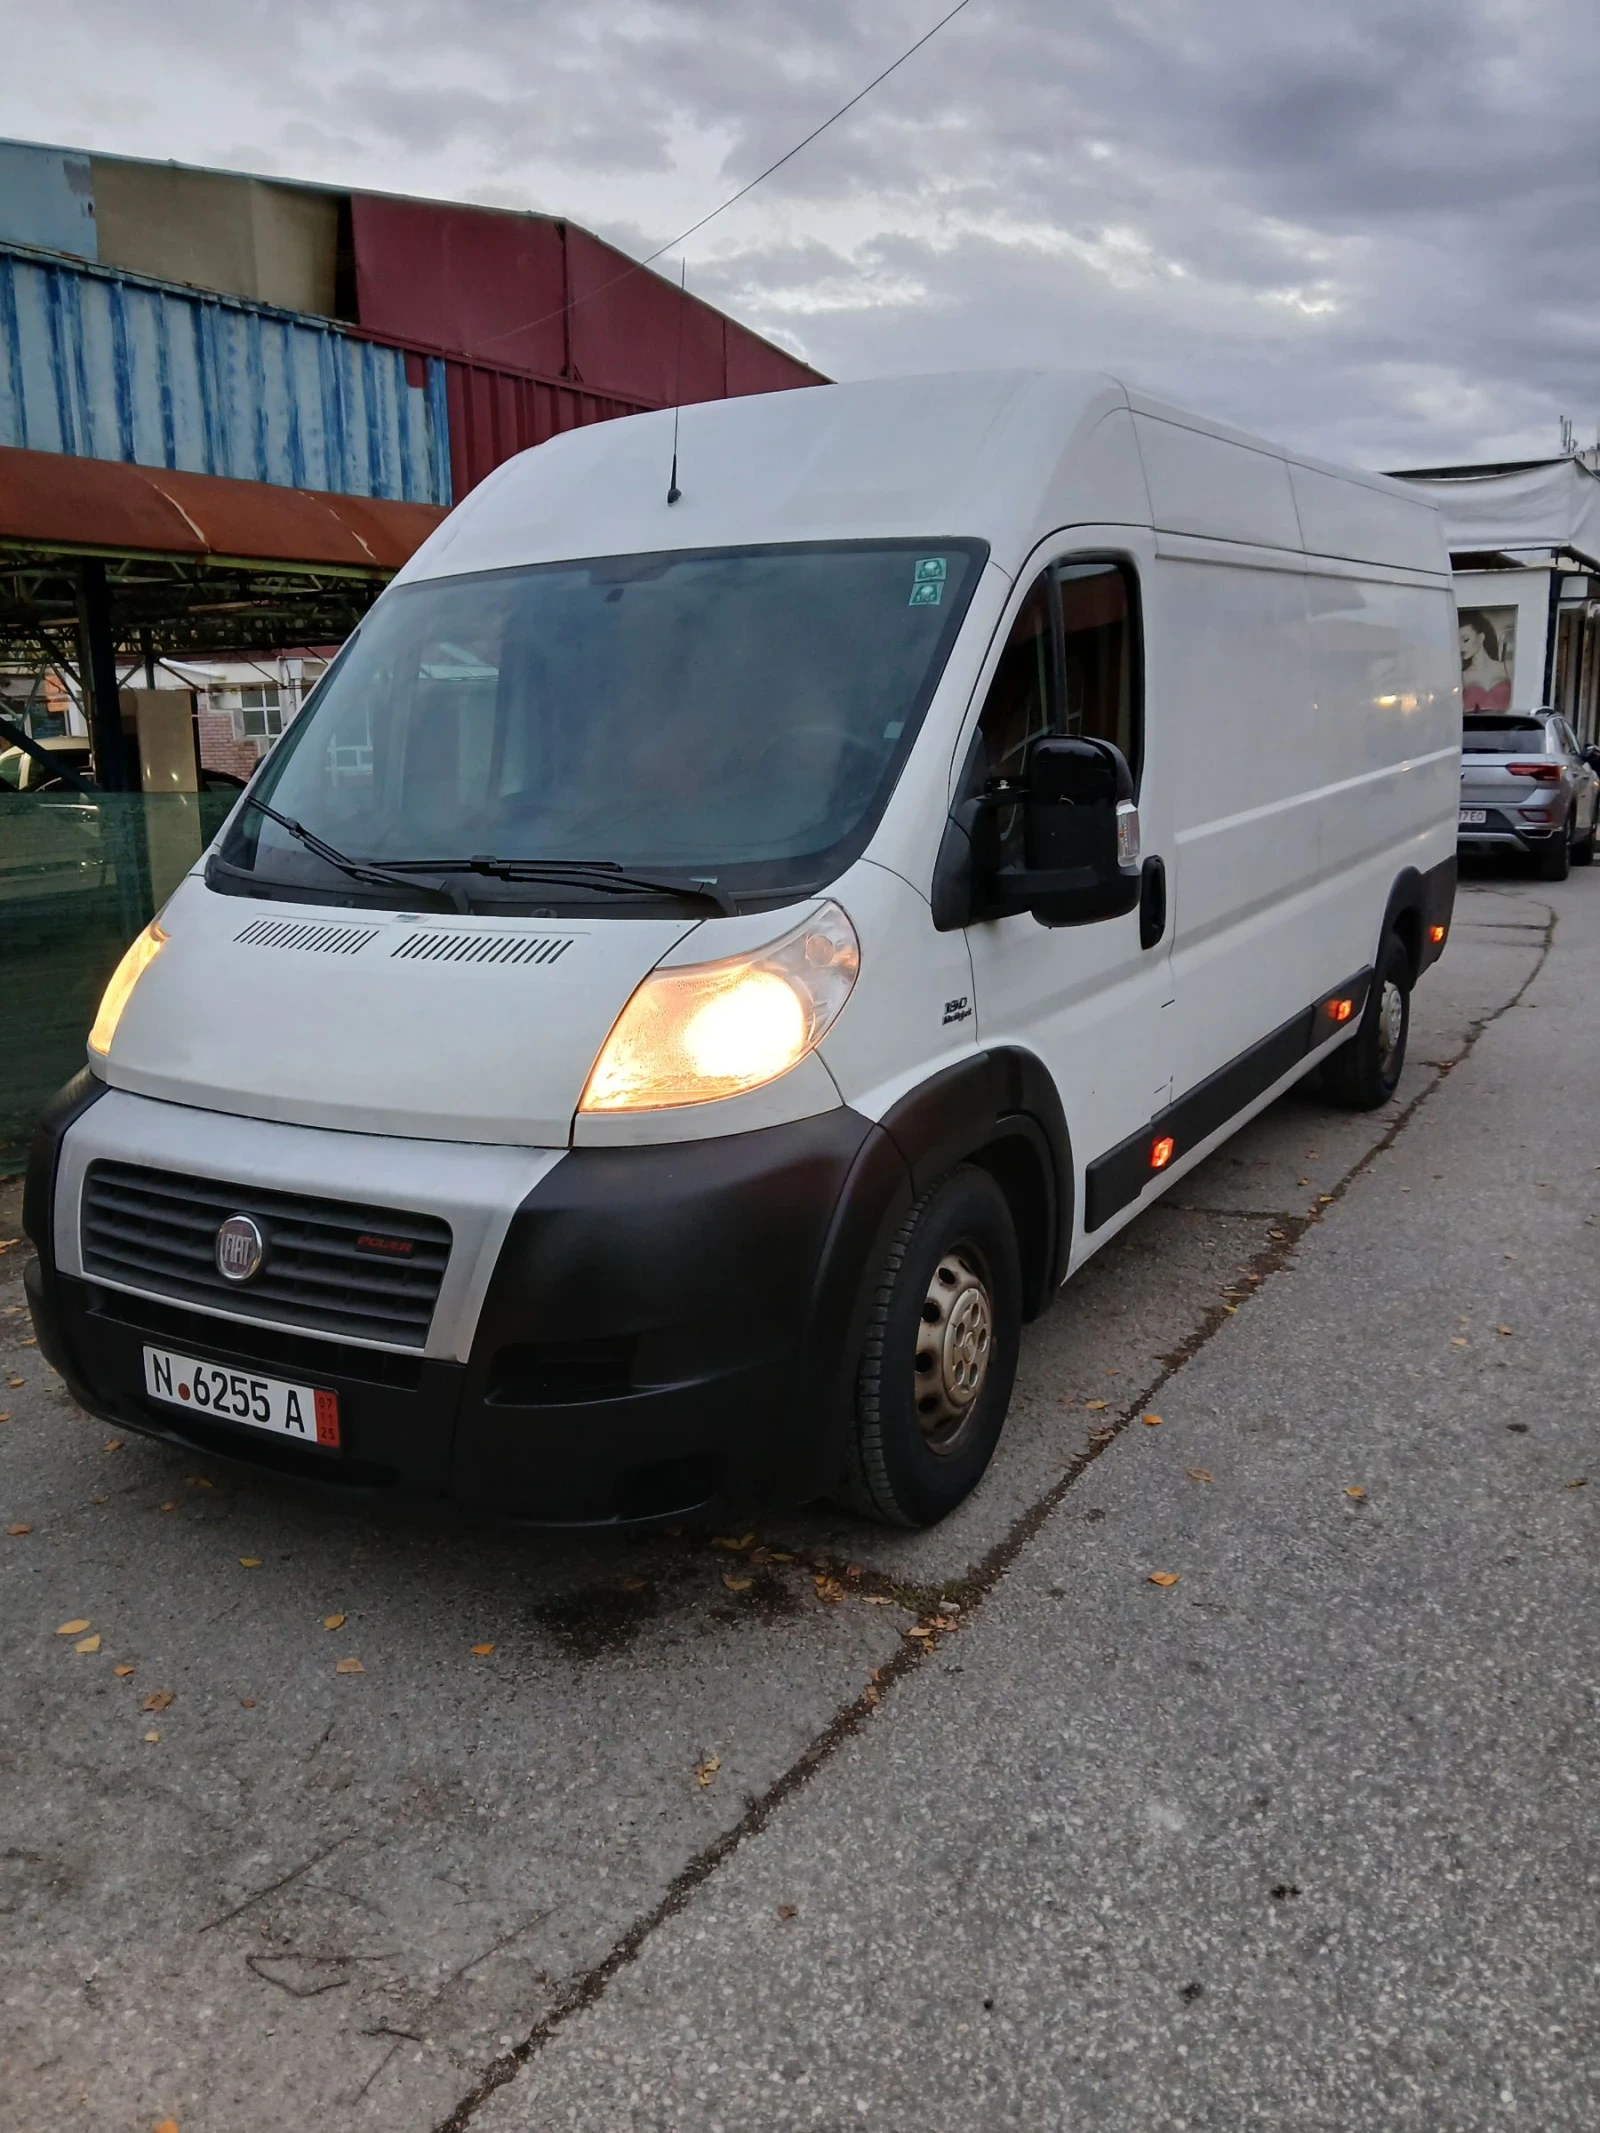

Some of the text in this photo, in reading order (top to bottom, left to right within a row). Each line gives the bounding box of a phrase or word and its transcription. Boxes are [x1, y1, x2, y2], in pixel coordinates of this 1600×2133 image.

[224, 1233, 252, 1266] FIAT
[152, 1353, 305, 1433] N 6255 A
[321, 1426, 336, 1440] 25
